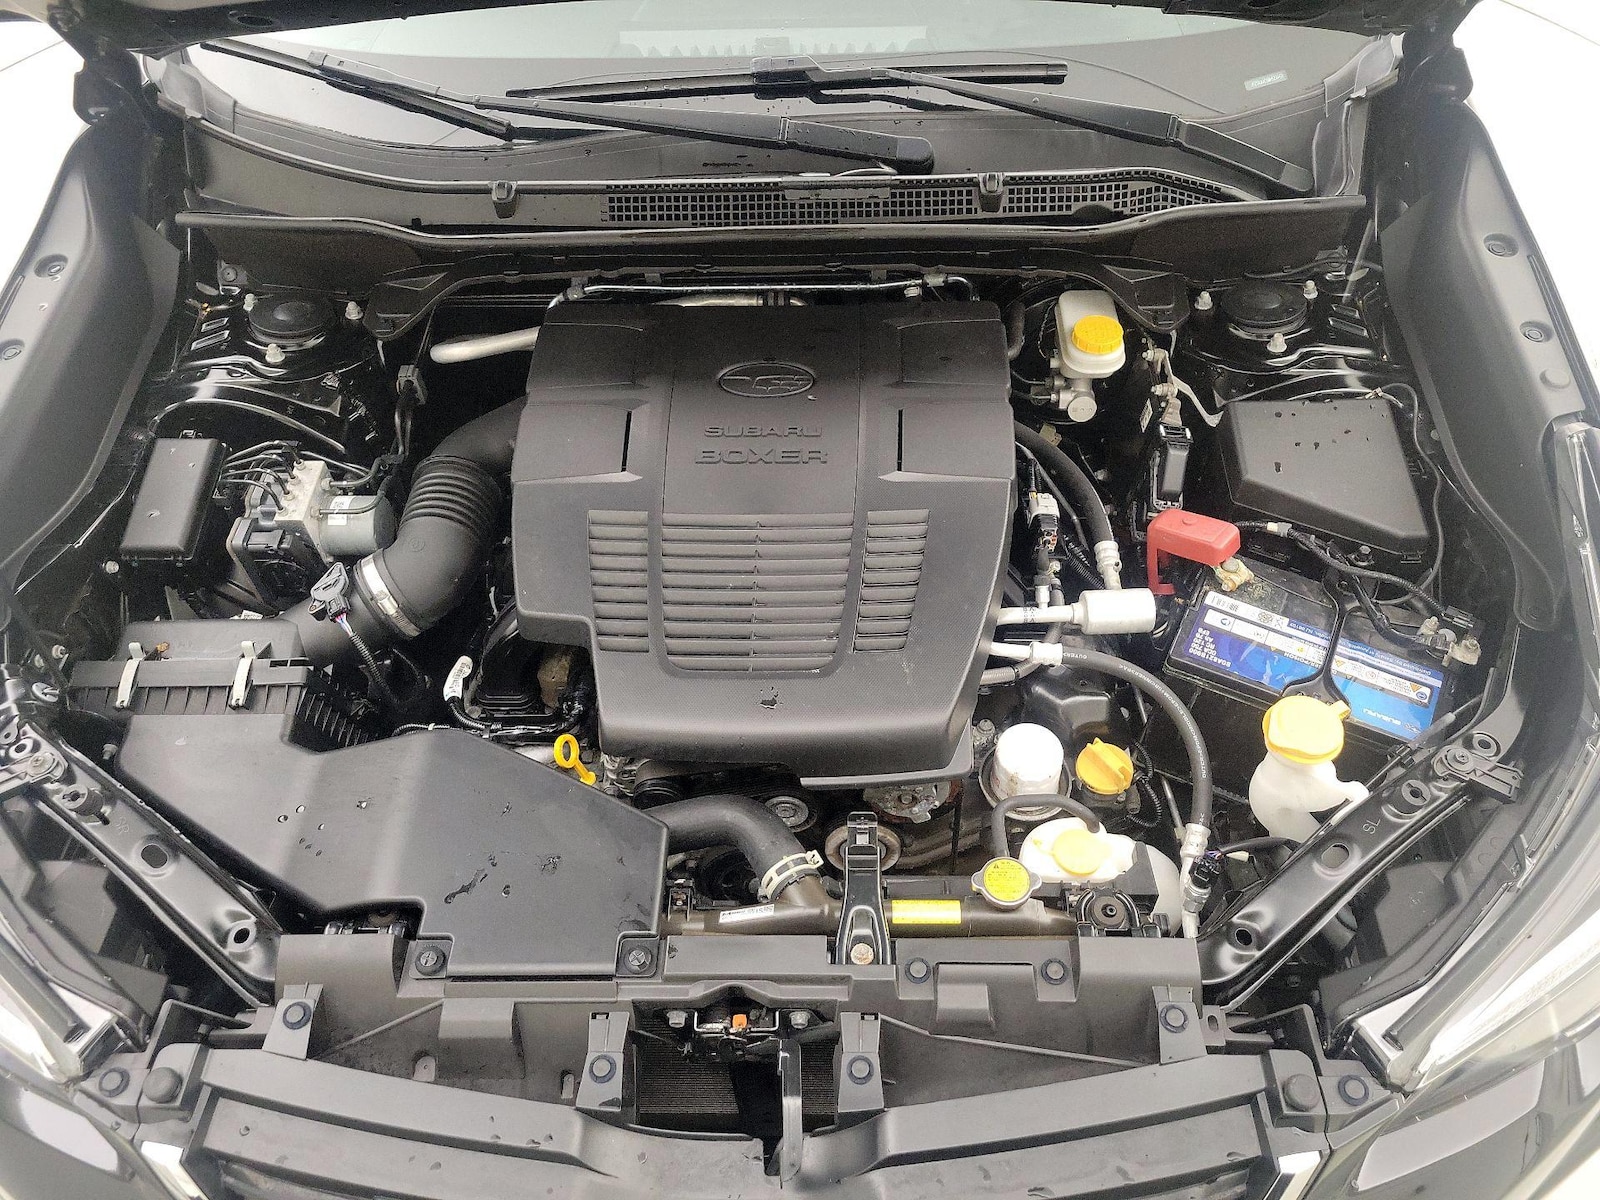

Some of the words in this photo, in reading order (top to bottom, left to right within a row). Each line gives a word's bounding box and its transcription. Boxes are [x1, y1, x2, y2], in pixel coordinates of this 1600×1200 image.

[704, 425, 823, 437] SUBARU
[695, 449, 828, 464] BOXER
[1363, 819, 1380, 834] SL
